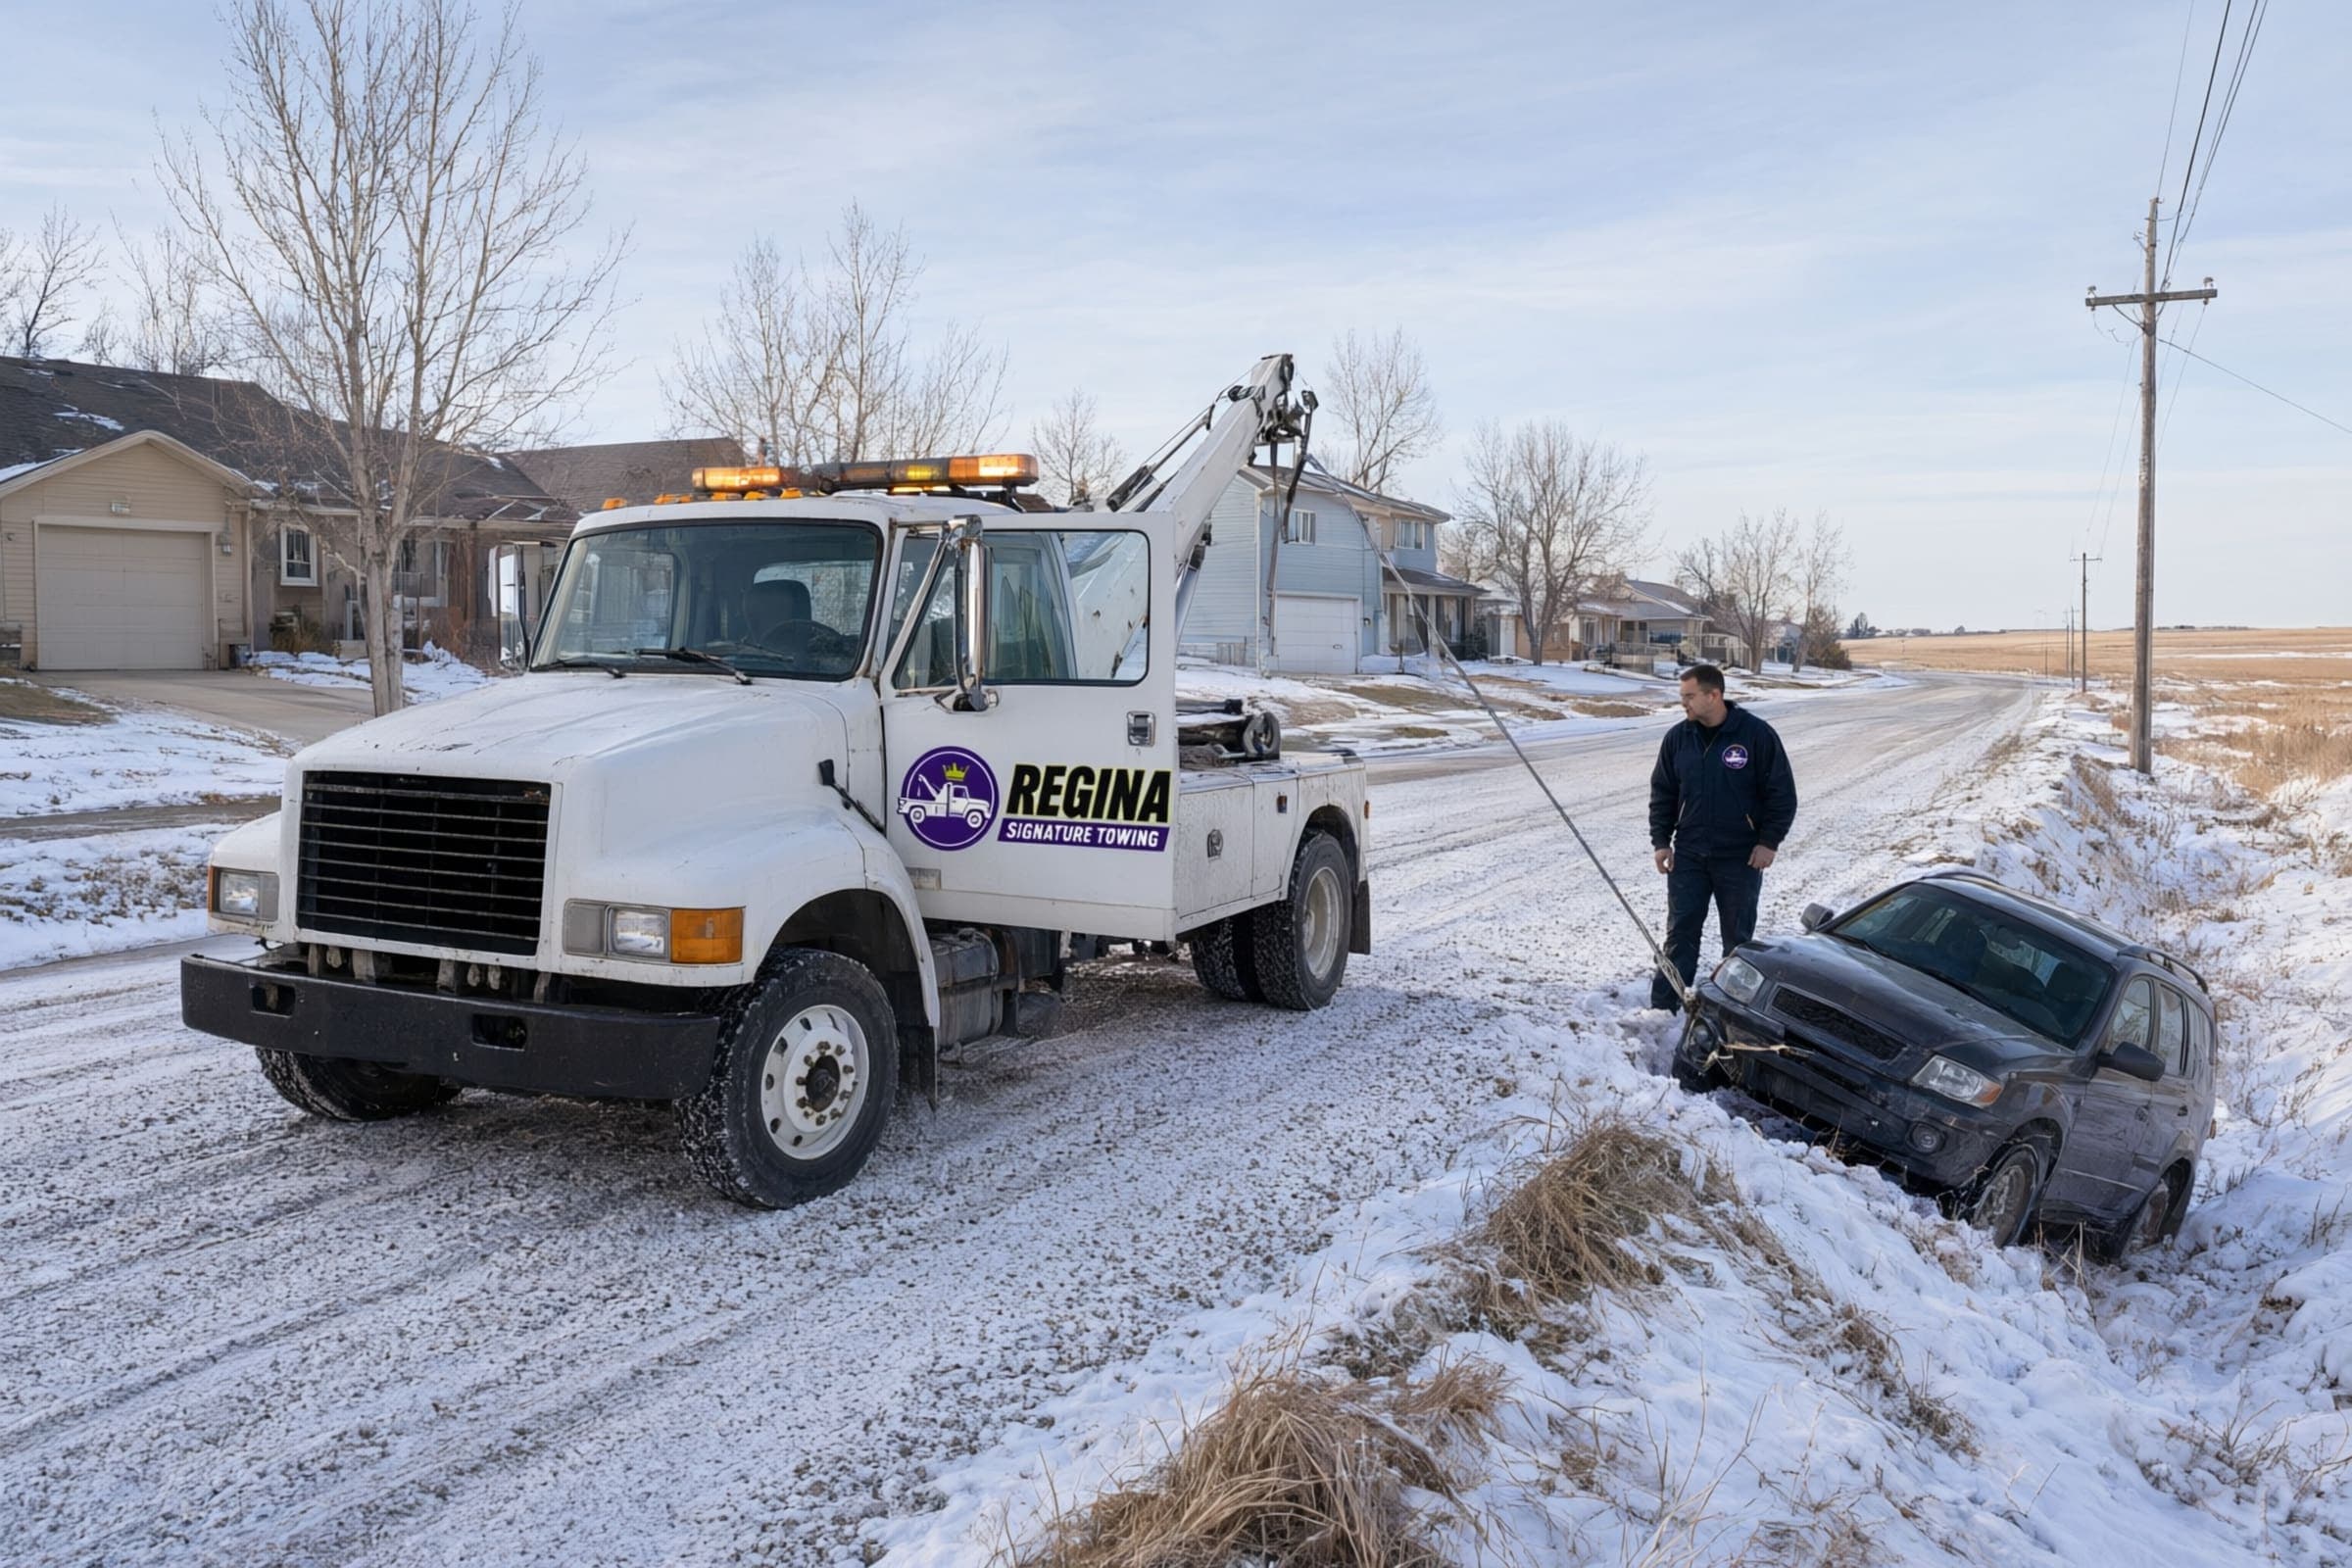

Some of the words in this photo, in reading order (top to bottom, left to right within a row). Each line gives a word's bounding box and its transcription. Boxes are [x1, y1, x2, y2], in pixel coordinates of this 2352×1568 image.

[1005, 763, 1171, 823] REGINA
[1006, 821, 1092, 844] SIGNATURE
[1097, 827, 1159, 848] TOWING
